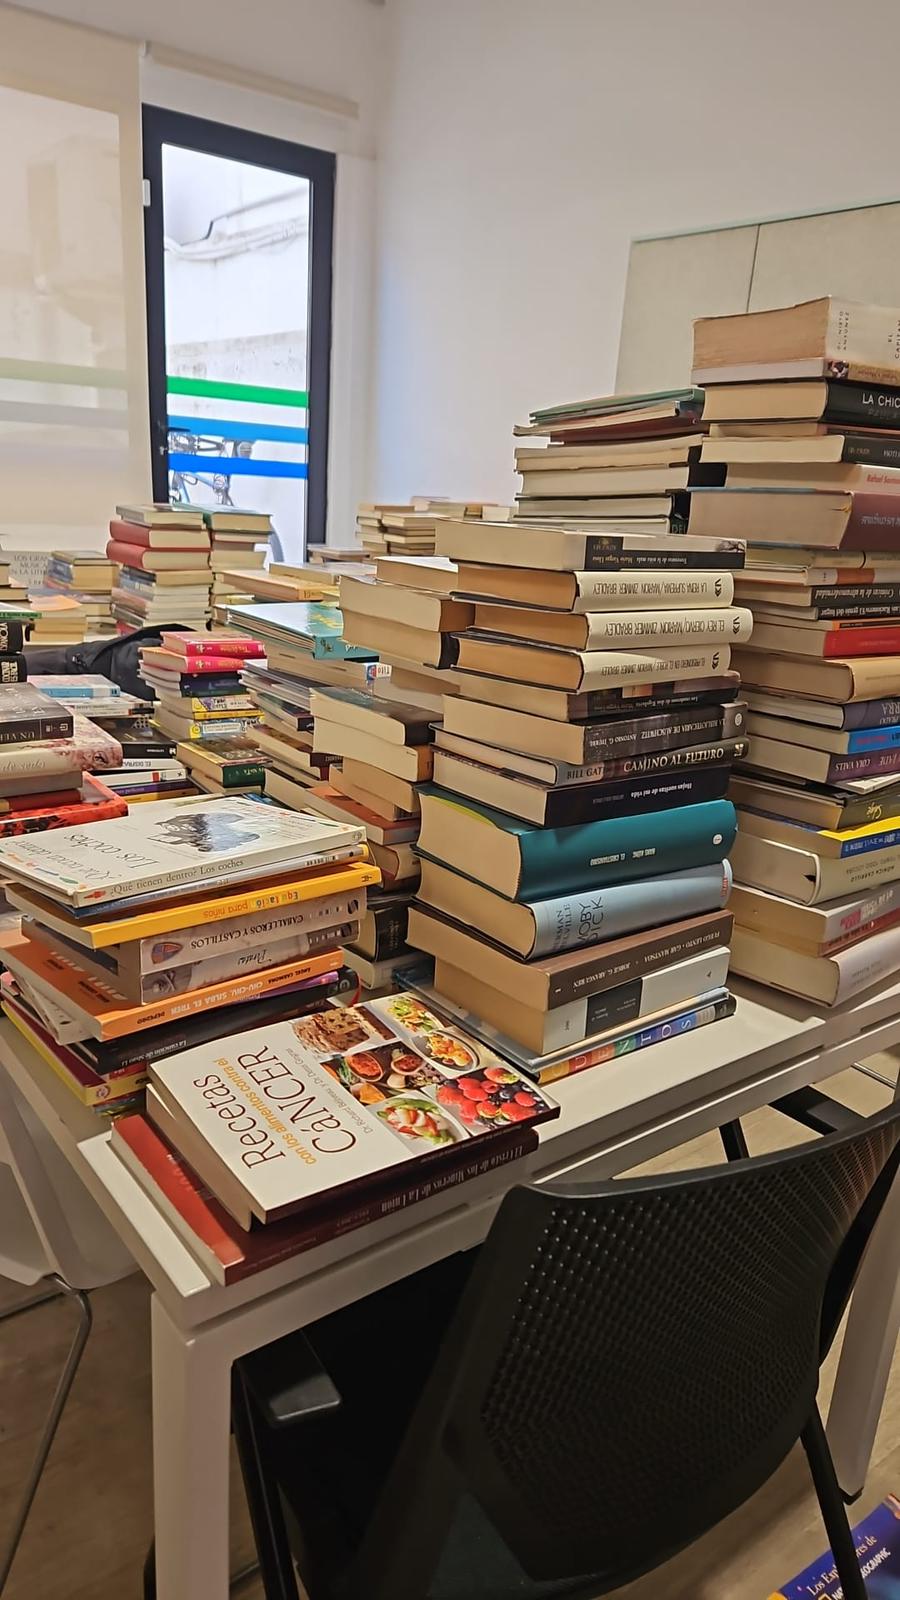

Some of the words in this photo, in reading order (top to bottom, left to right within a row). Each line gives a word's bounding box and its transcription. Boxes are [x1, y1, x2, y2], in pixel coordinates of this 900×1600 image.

[862, 393, 874, 405] LA
[592, 582, 617, 595] BRADLEY
[618, 582, 638, 594] ZIMMER
[700, 582, 707, 593] LA
[604, 622, 633, 636] BRADLEY
[634, 622, 658, 635] ZIMMER
[707, 620, 718, 632] REY
[718, 620, 725, 631] EL
[673, 726, 681, 734] DE
[614, 733, 637, 744] ANTONIO
[567, 768, 585, 780] BILL
[623, 755, 668, 773] CAMINO
[670, 753, 682, 765] AL
[685, 747, 724, 763] FUTURO
[630, 789, 643, 798] vida
[651, 787, 658, 795] de
[110, 883, 133, 897] ¿Qué
[136, 877, 163, 890] tienen
[166, 867, 198, 883] dentro?
[200, 865, 216, 876] Los
[218, 859, 244, 871] coches
[203, 908, 226, 919] niños
[228, 902, 248, 914] para
[250, 914, 304, 935] CABALLEROS
[577, 902, 593, 943] MOBY
[242, 927, 249, 937] Y
[190, 930, 241, 950] CASTILLOS
[268, 973, 293, 985] CARMONA
[192, 998, 203, 1009] EL
[204, 991, 229, 1005] SILBA
[213, 1057, 228, 1071] el
[223, 1064, 252, 1092] contra
[245, 1089, 288, 1135] alimentos
[192, 1073, 287, 1169] Recetas
[282, 1133, 303, 1151] los
[297, 1146, 317, 1166] con
[467, 1165, 479, 1176] los
[480, 1159, 490, 1171] de
[433, 1170, 465, 1190] Mineros
[408, 1189, 420, 1202] La
[421, 1184, 432, 1196] de
[806, 1580, 826, 1596] Los
[864, 1534, 877, 1547] de
